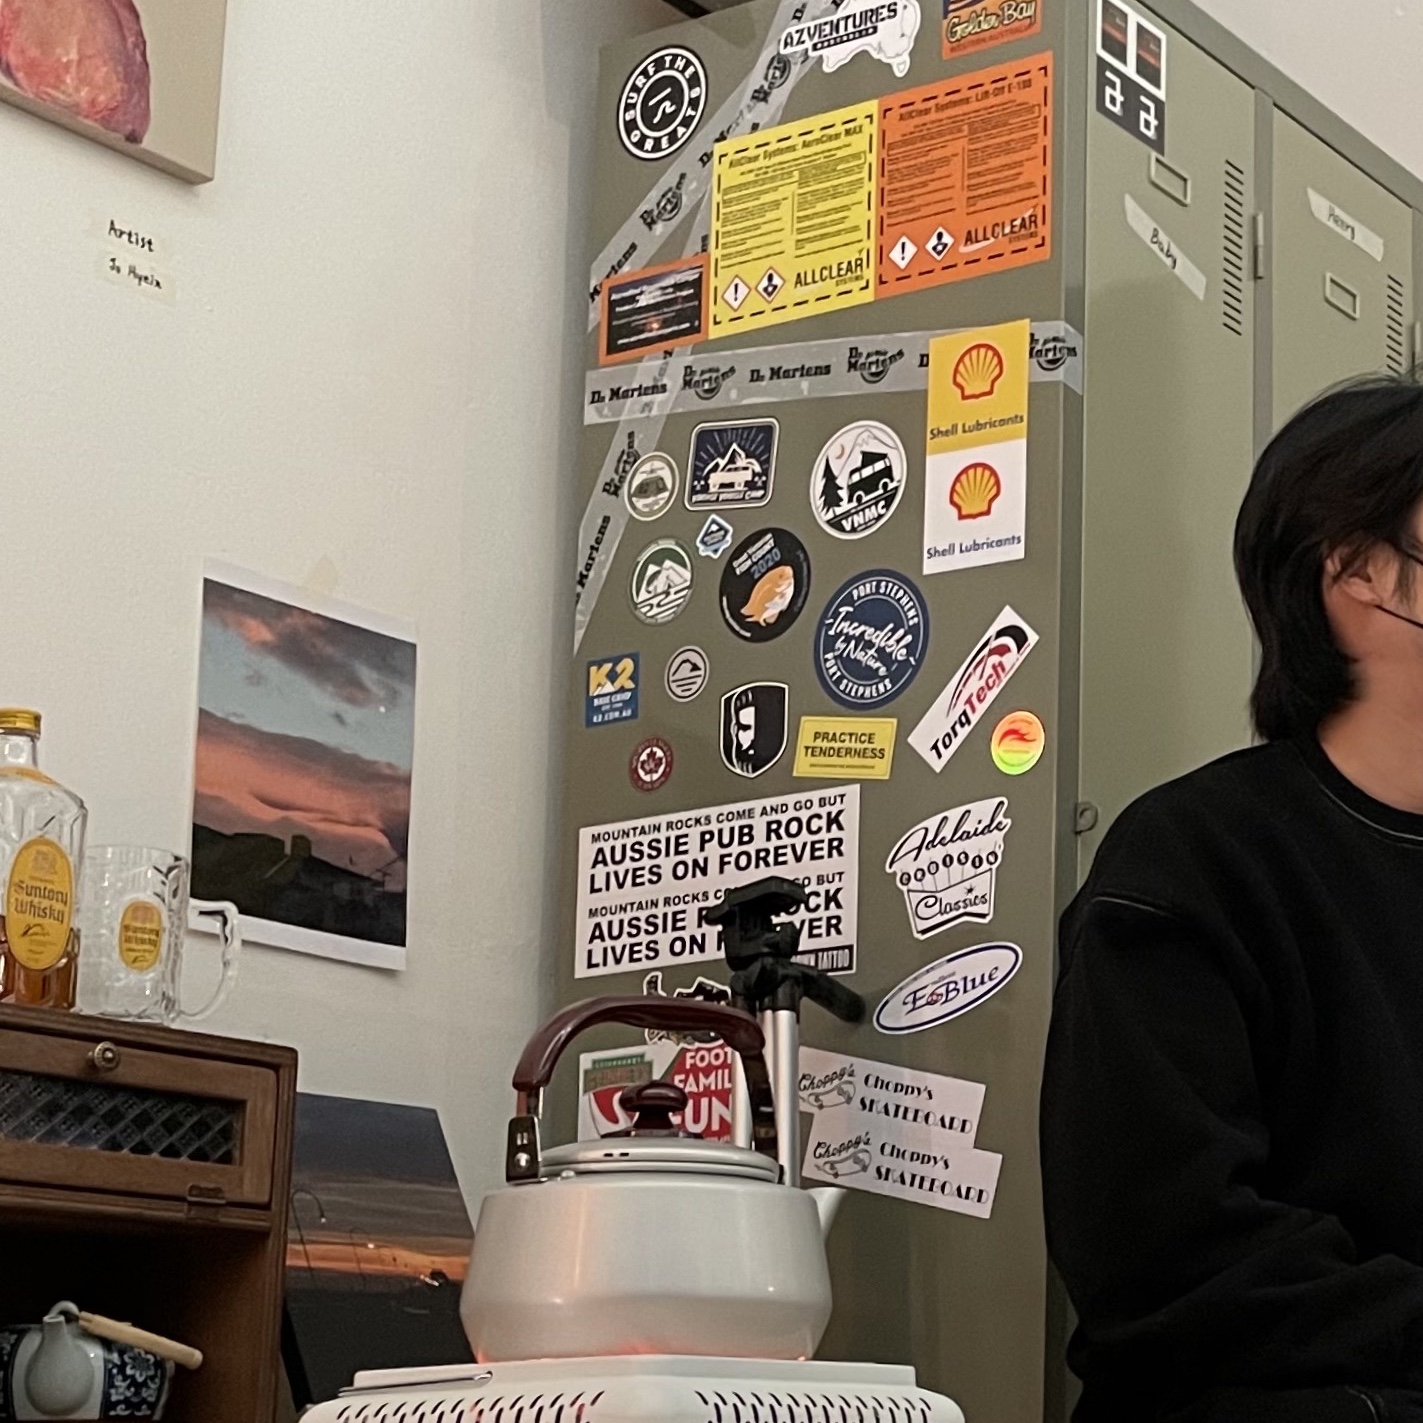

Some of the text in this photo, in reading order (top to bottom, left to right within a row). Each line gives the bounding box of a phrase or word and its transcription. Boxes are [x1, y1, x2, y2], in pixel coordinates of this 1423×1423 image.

[783, 2, 898, 50] AZVENTURES
[946, 0, 1037, 43] Golden Bay
[624, 62, 656, 121] SURF
[664, 56, 696, 79] THE
[108, 219, 154, 253] Artist
[963, 214, 1039, 247] ALLCLEAR
[1150, 227, 1178, 270] Baby
[793, 257, 864, 289] ALLCLEAR
[768, 363, 832, 381] Martens
[608, 383, 668, 402] Martens
[929, 413, 1024, 440] Shell Lubricants
[841, 499, 887, 532] VNMC
[576, 514, 611, 590] Martens
[750, 547, 781, 580] 2020
[926, 535, 1022, 560] Shell Lubricants
[852, 581, 919, 626] PORT STEPHENS
[827, 605, 913, 661] Incredible
[823, 651, 892, 698] PORT STEPHENS
[833, 635, 889, 677] by Nature
[588, 657, 636, 697] K2
[929, 660, 1007, 760] TorqTech
[803, 745, 886, 760] TENDERNESS
[812, 731, 876, 744] PRACTICE
[590, 793, 847, 845] MOUNTAIN ROCKS COME AND GO BUT
[888, 800, 1008, 869] Adelaide
[590, 808, 846, 870] AUSSIE PUB ROCK
[589, 837, 845, 895] LIVES ON FOREVER
[14, 896, 65, 925] Whisky
[588, 898, 659, 919] MOUNTAIN
[663, 890, 710, 907] ROCKS
[816, 871, 845, 886] BUT
[914, 892, 989, 921] Classics
[588, 909, 687, 945] AUSSIE
[586, 940, 660, 970] LIVES
[669, 933, 707, 957] ON
[673, 1069, 732, 1093] FAMIL
[859, 1096, 973, 1135] SKATEBOARD
[875, 1164, 990, 1205] SKATEBOARD
